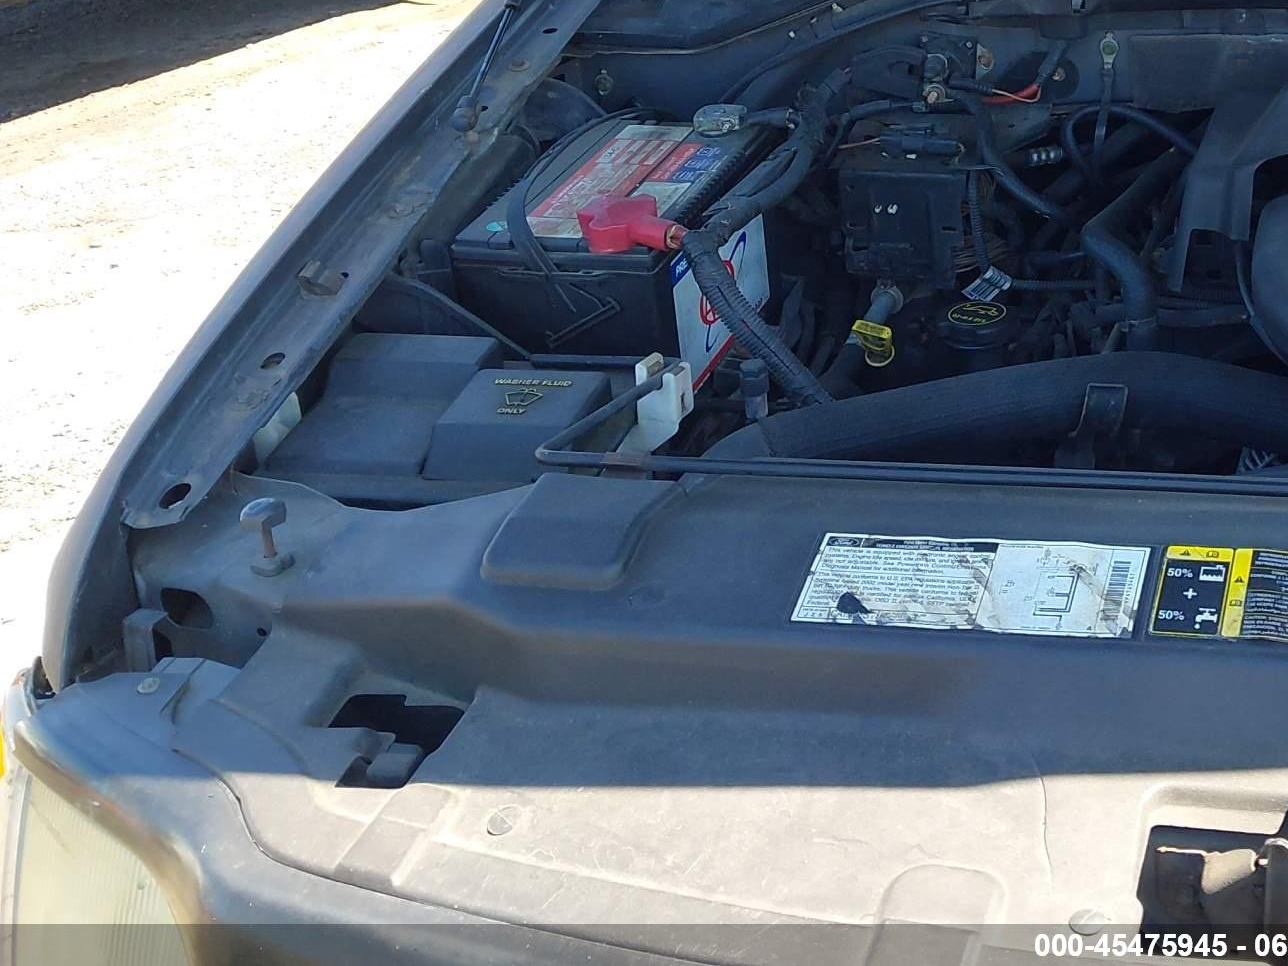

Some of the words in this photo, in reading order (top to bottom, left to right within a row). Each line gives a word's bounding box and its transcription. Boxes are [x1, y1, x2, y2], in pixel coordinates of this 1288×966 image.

[495, 377, 540, 386] WASHER
[541, 379, 572, 387] FLUID
[496, 407, 526, 415] ONLY
[1167, 568, 1194, 578] 50%
[1158, 610, 1185, 620] 50%
